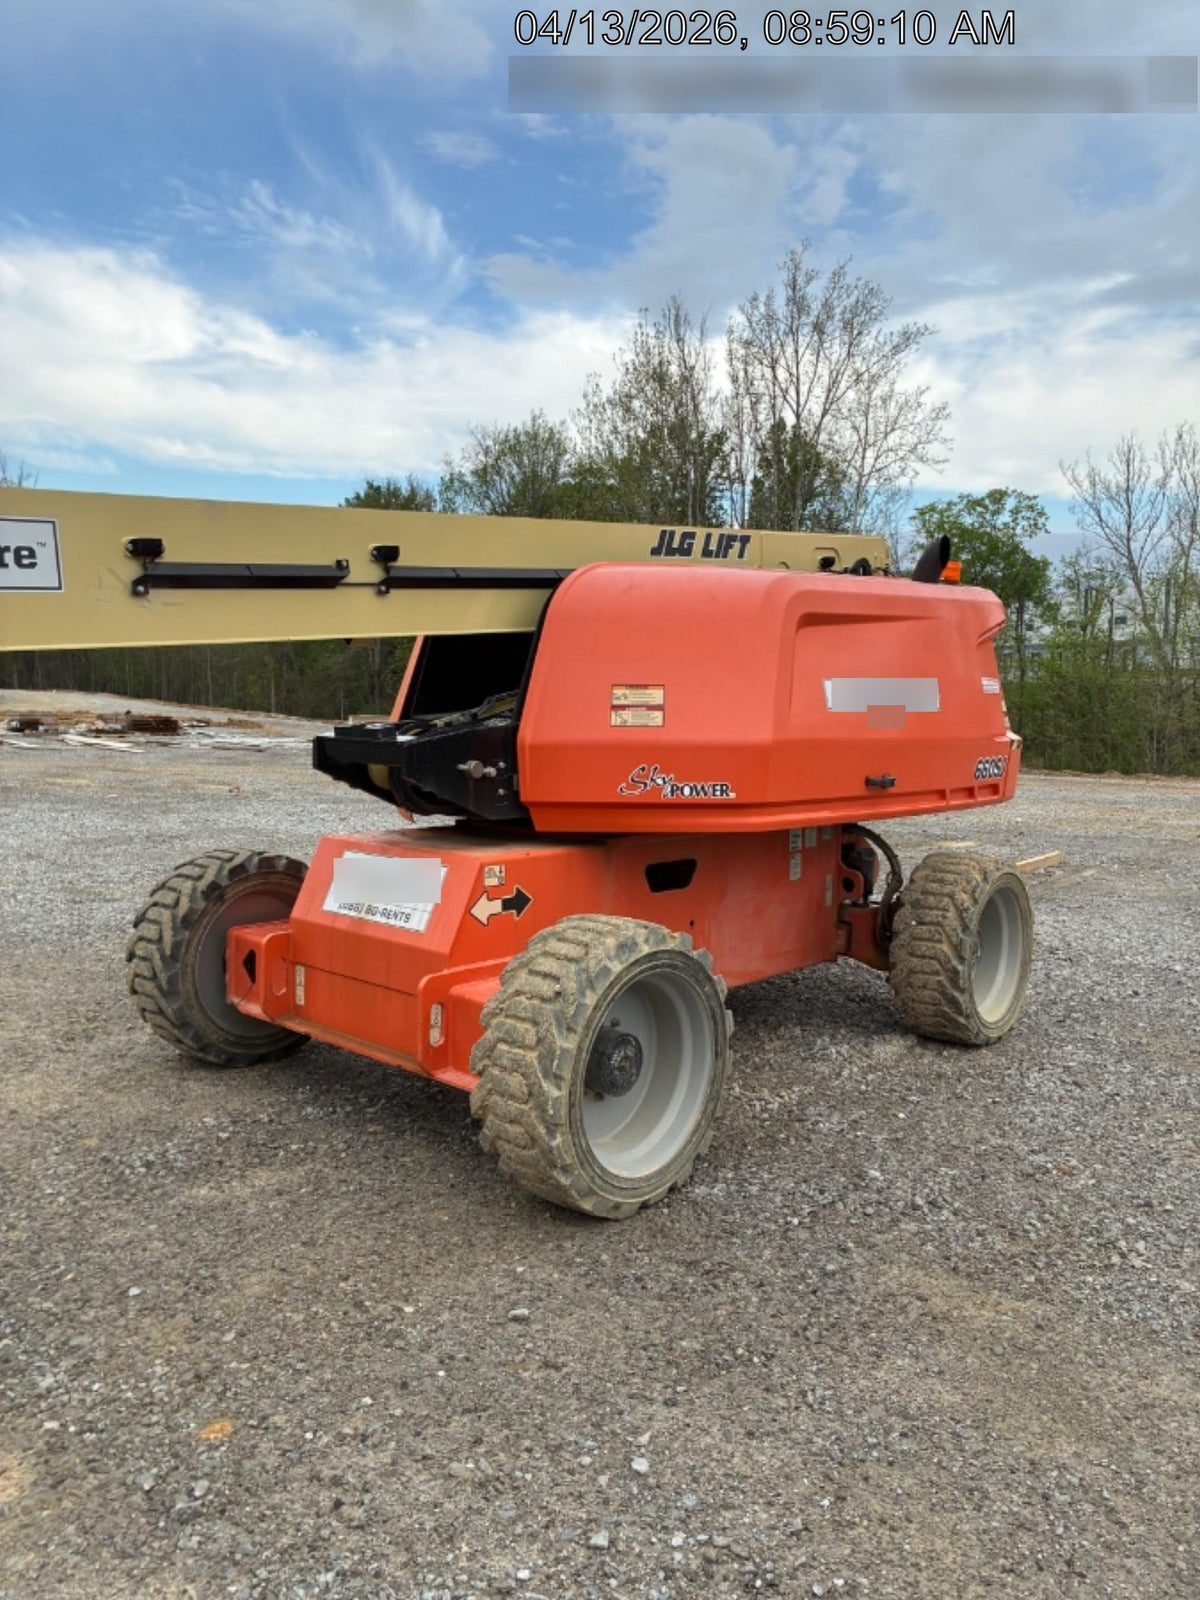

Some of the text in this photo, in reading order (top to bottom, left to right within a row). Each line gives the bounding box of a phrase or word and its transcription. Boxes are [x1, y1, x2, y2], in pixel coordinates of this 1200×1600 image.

[650, 529, 752, 559] JLG LIFT
[618, 764, 732, 799] Sky POWER
